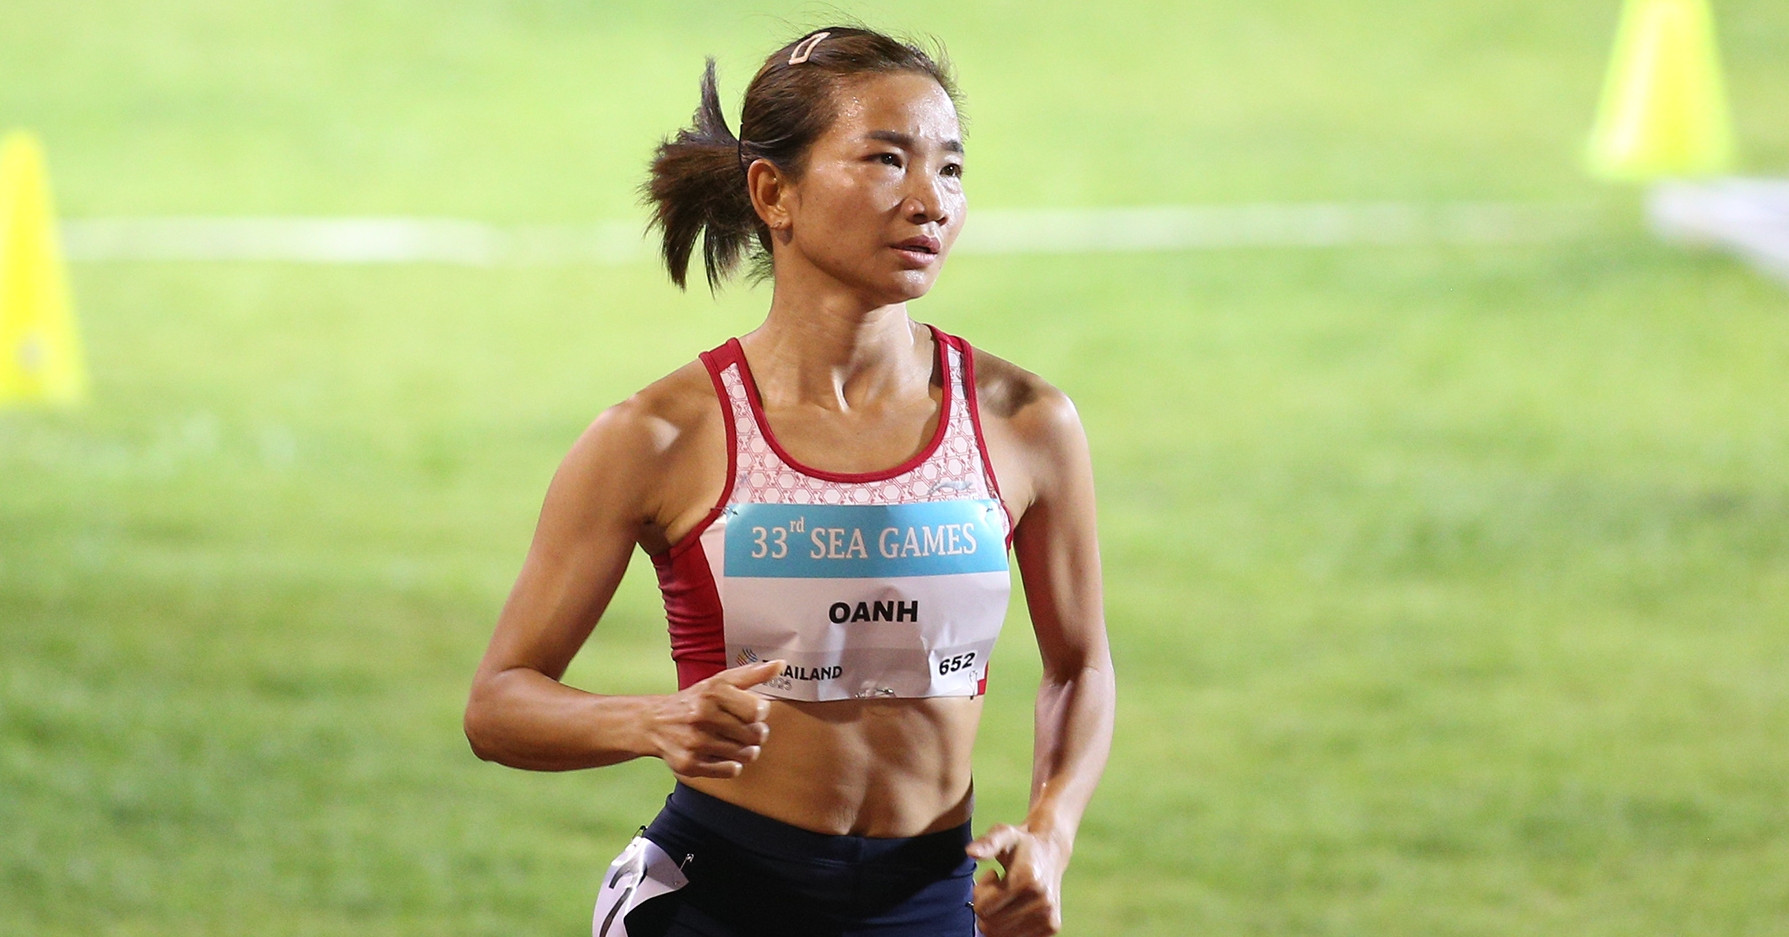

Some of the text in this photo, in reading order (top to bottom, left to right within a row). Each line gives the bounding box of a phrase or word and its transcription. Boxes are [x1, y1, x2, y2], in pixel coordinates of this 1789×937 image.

[751, 517, 977, 559] 33rd SEA GAMES
[829, 600, 918, 624] OANH
[763, 660, 843, 680] AILAND
[939, 652, 975, 675] 652
